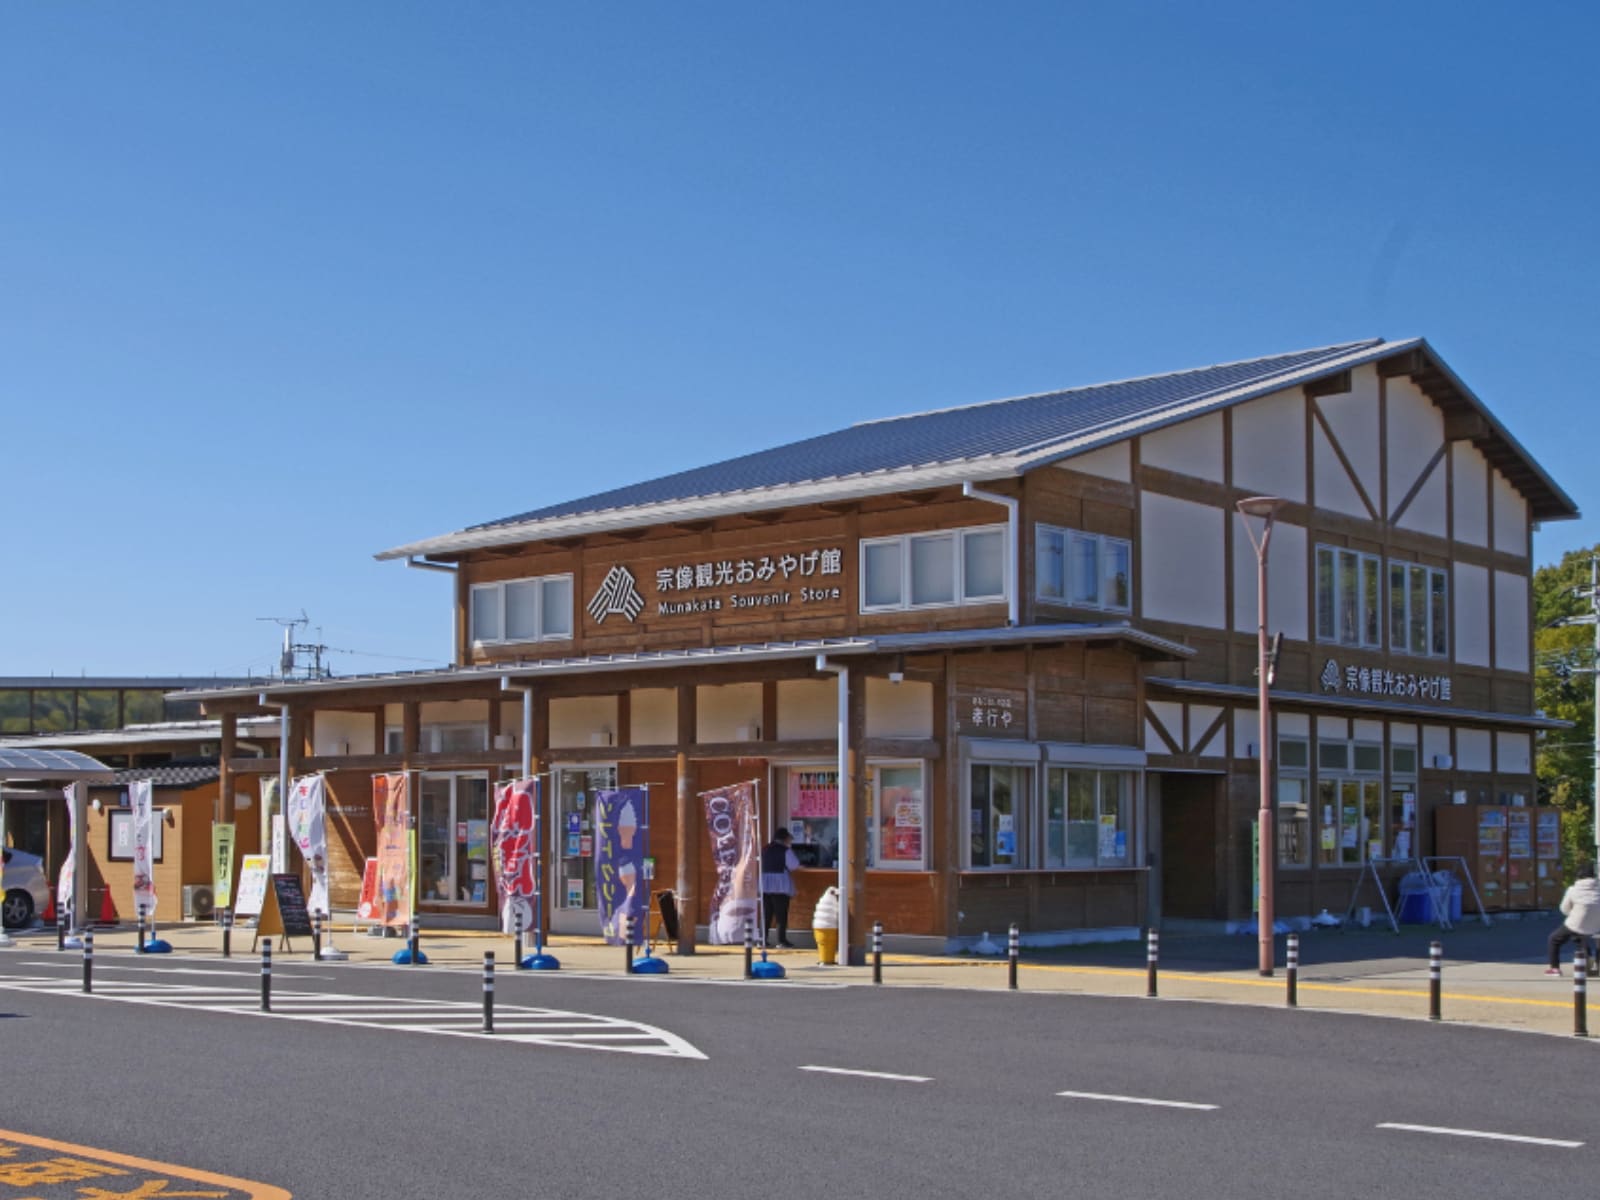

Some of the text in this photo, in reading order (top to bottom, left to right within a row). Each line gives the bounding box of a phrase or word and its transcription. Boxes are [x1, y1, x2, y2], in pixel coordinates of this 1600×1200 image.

[656, 548, 842, 592] 宗像観光おみやげ館
[658, 587, 840, 615] Munakata Souvenir Store
